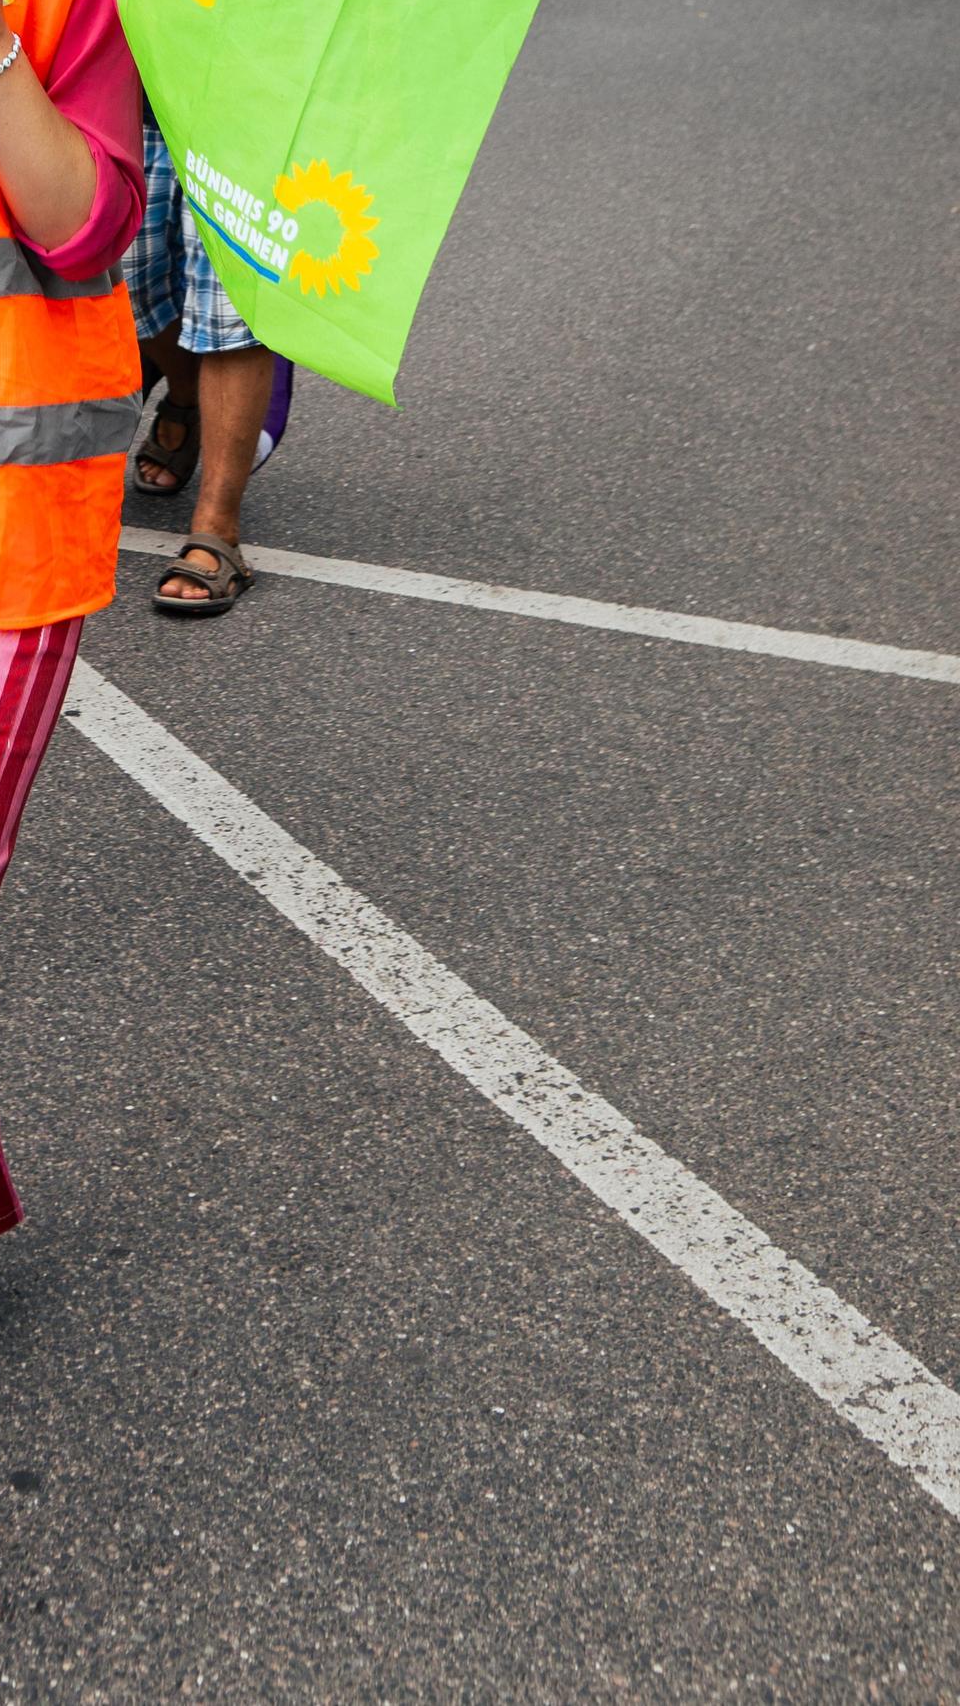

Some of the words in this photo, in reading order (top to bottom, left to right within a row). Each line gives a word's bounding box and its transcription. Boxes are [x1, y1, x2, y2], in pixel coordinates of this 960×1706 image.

[185, 147, 265, 222] BÜNDNIS
[267, 210, 299, 242] 90
[185, 173, 208, 210] DIE
[213, 200, 289, 271] GRÜNEN
